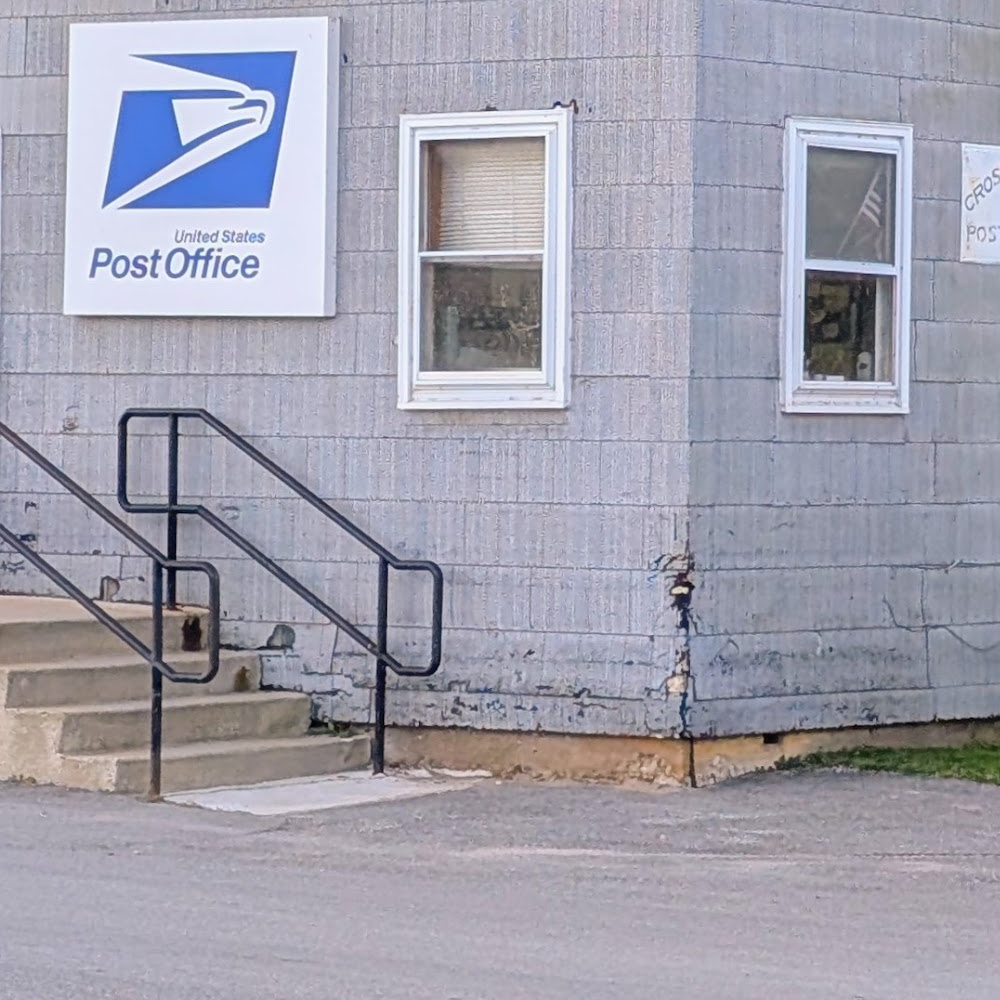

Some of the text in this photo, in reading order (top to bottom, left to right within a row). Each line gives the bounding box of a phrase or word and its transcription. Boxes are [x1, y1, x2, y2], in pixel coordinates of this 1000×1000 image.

[174, 229, 266, 244] United States
[88, 247, 260, 279] Post Office
